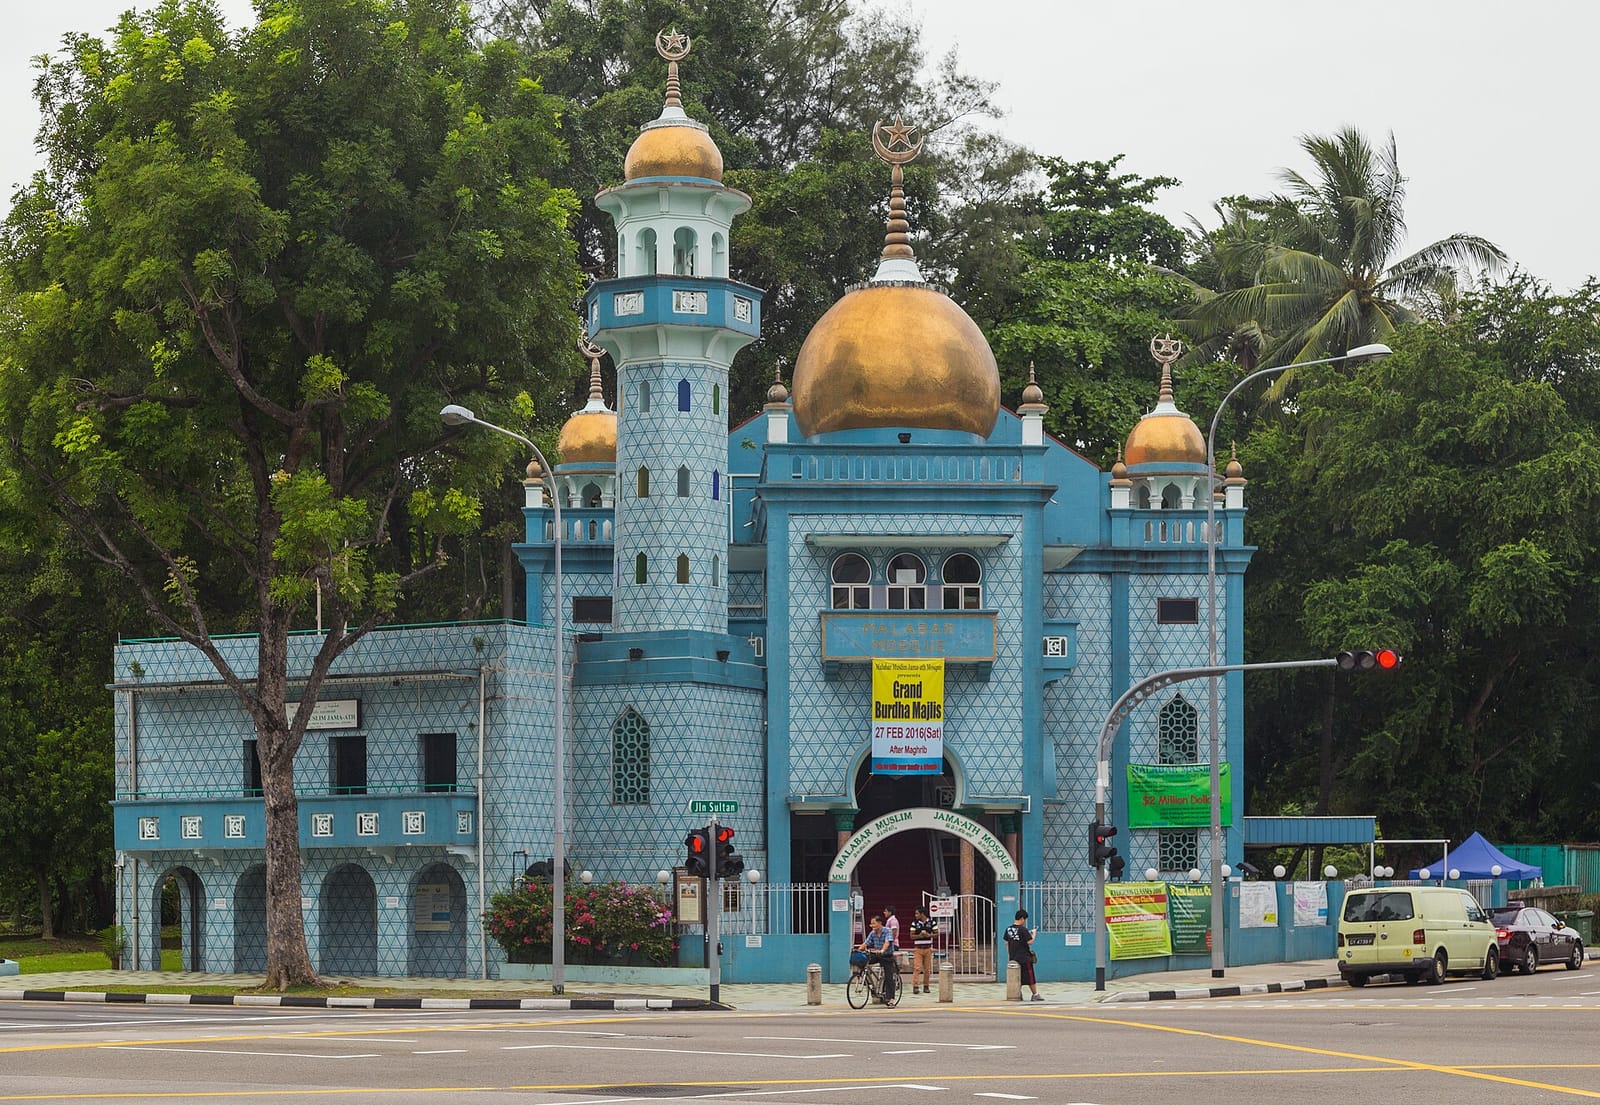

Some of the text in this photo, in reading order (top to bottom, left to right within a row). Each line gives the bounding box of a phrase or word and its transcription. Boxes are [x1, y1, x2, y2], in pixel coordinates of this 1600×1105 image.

[863, 623, 954, 636] MALABAR
[872, 639, 945, 653] MOSQUE
[893, 680, 922, 698] Grand
[875, 700, 942, 720] Burdha Majlis
[875, 726, 942, 741] 27 FEB 2016(Sat)
[889, 746, 928, 756] After Maghrib
[694, 802, 735, 812] Jln Sultan
[1142, 794, 1156, 806] $2
[1158, 794, 1188, 804] Million
[836, 828, 872, 869] MALABAR
[874, 812, 912, 830] MUSLIM
[981, 833, 1012, 869] MOSQUE
